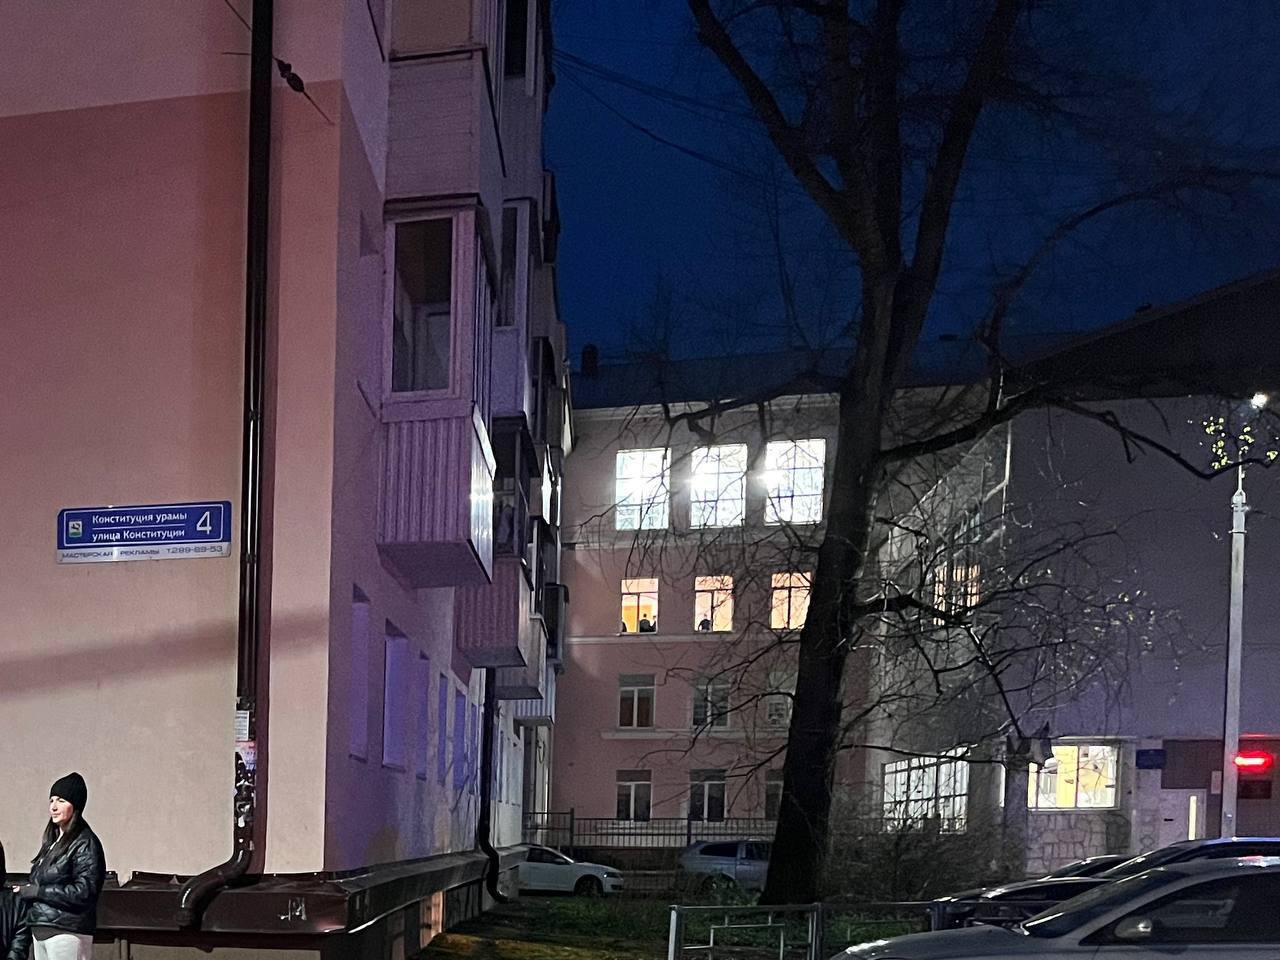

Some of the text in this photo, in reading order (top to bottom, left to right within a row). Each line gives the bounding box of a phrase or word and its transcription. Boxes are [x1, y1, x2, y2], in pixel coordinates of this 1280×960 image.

[92, 512, 187, 525] Конституция урамы
[195, 510, 212, 535] 4
[92, 529, 185, 542] улица Конституции
